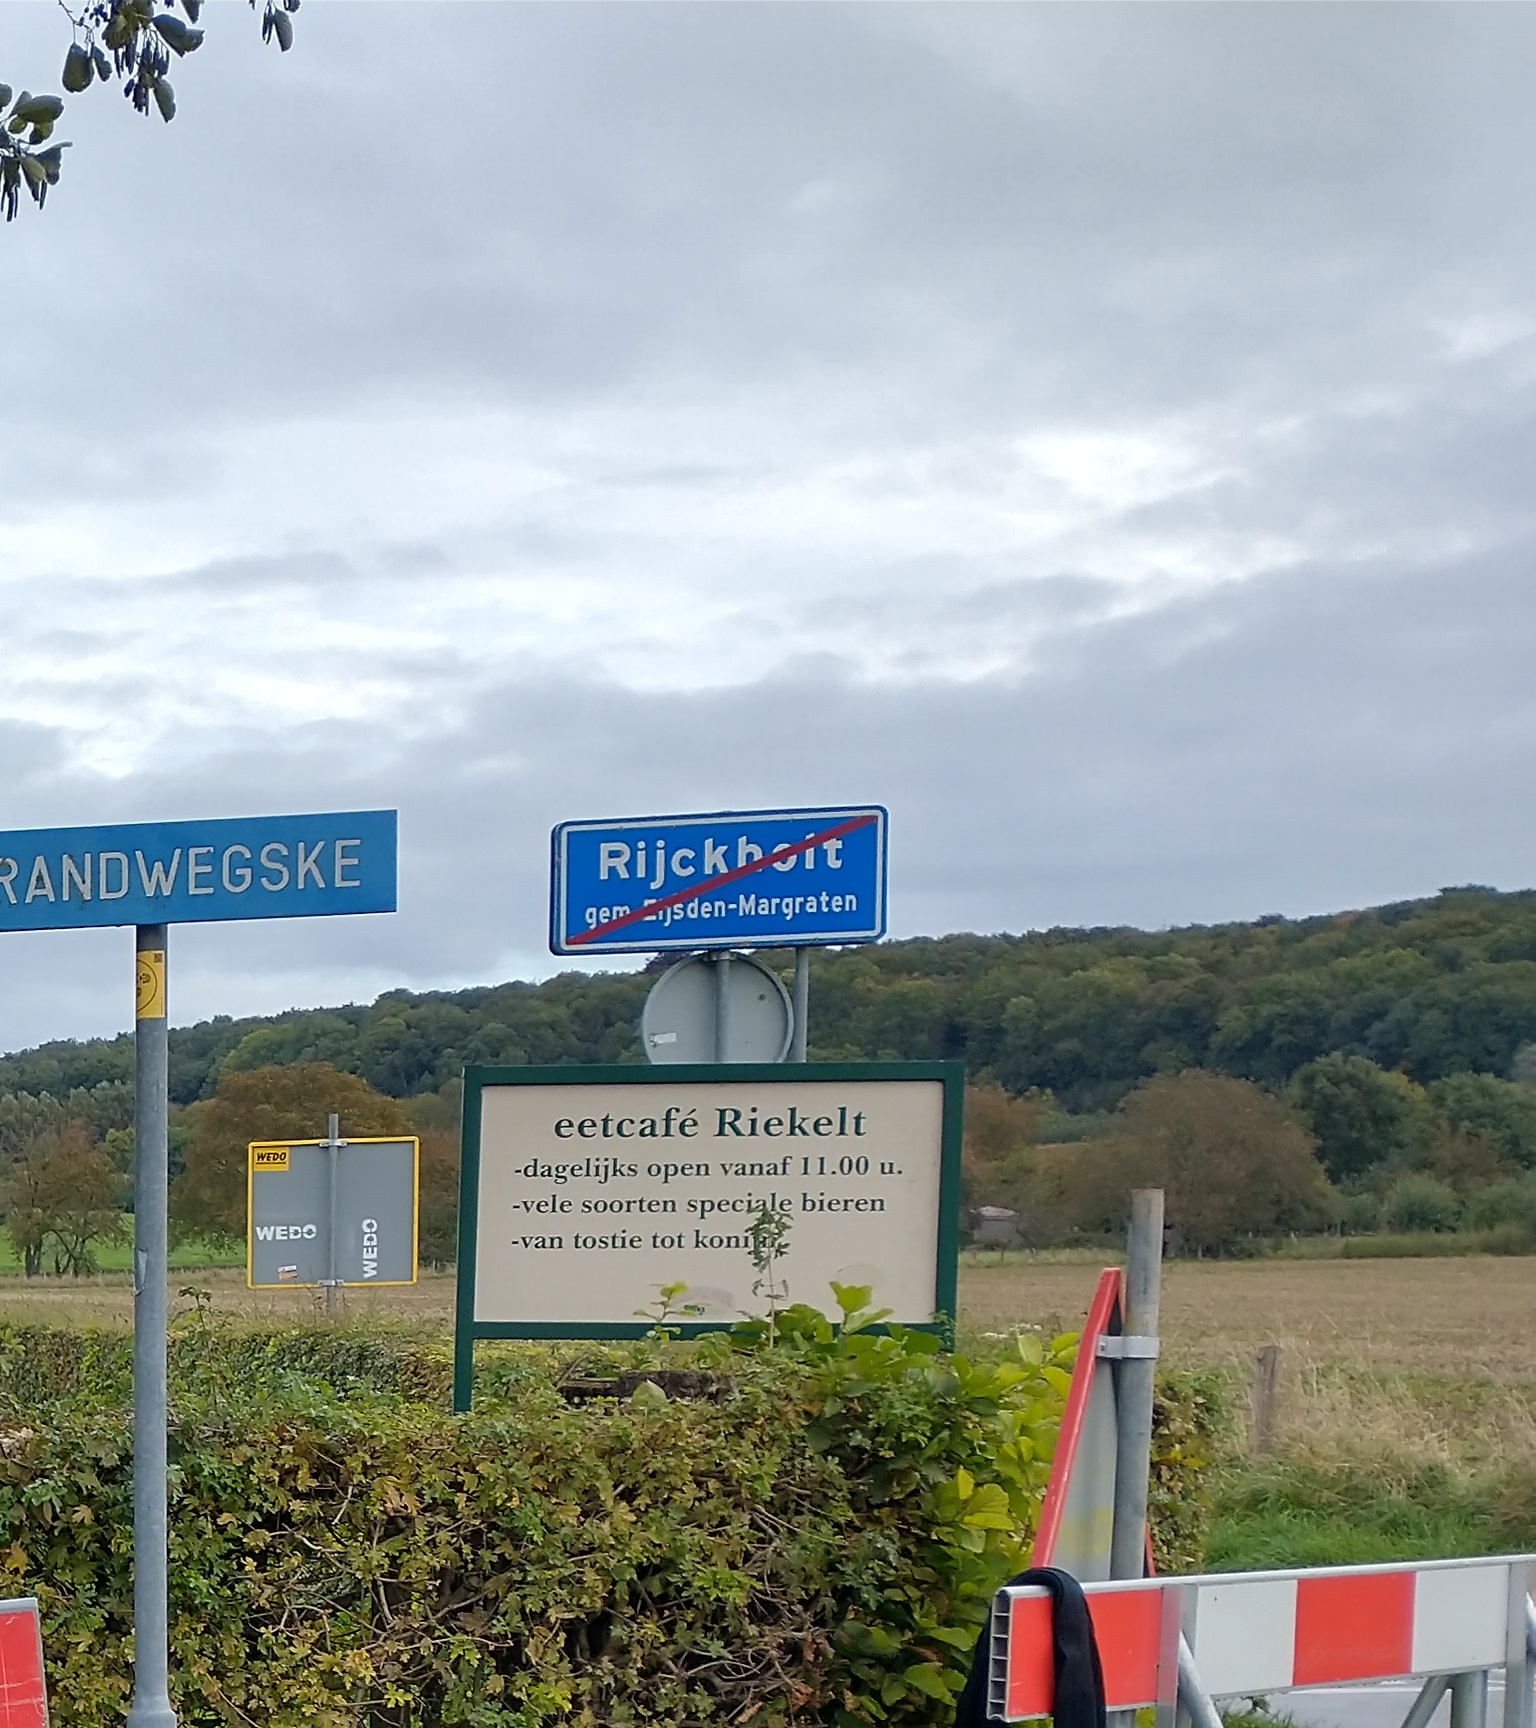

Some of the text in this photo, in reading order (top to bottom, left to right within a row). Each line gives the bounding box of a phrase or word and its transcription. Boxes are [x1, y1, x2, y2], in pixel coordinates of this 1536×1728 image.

[599, 833, 843, 890] Rijckholt
[554, 1106, 867, 1139] eetcafé Riekelt
[256, 1152, 287, 1162] WEDO
[514, 1155, 904, 1184] -dagelijks open vanaf 11.00 u.
[512, 1192, 886, 1220] -vele soorten speciale bieren
[255, 1224, 317, 1241] WEDO
[511, 1234, 563, 1249] -van
[573, 1229, 642, 1249] tostie
[652, 1232, 686, 1249] tot
[362, 1218, 378, 1279] WEDO
